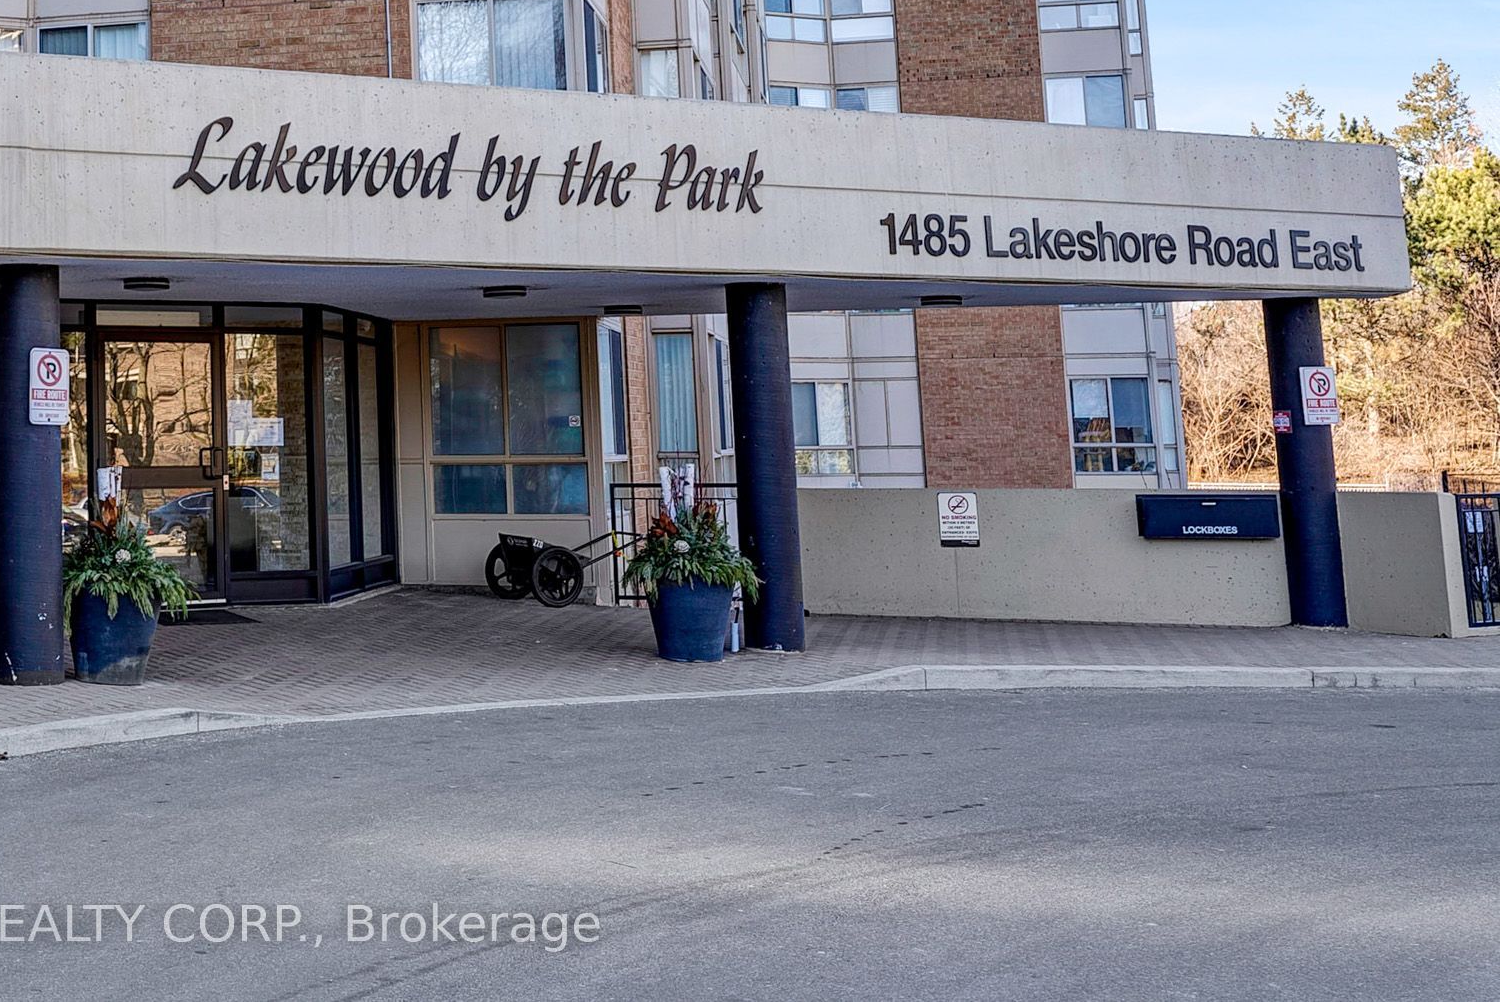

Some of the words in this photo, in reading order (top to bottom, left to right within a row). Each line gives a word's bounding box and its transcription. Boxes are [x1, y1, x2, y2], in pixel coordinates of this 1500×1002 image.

[173, 116, 461, 201] Lakewood
[476, 134, 542, 223] by
[559, 140, 637, 208] the
[654, 143, 764, 214] Park
[881, 212, 971, 258] 1485
[985, 215, 1177, 265] Lakeshore
[1187, 224, 1279, 269] Road
[1288, 229, 1365, 273] East
[34, 389, 46, 399] FIRE
[47, 390, 66, 400] ROUTE
[1182, 525, 1238, 535] LOCKBOXES
